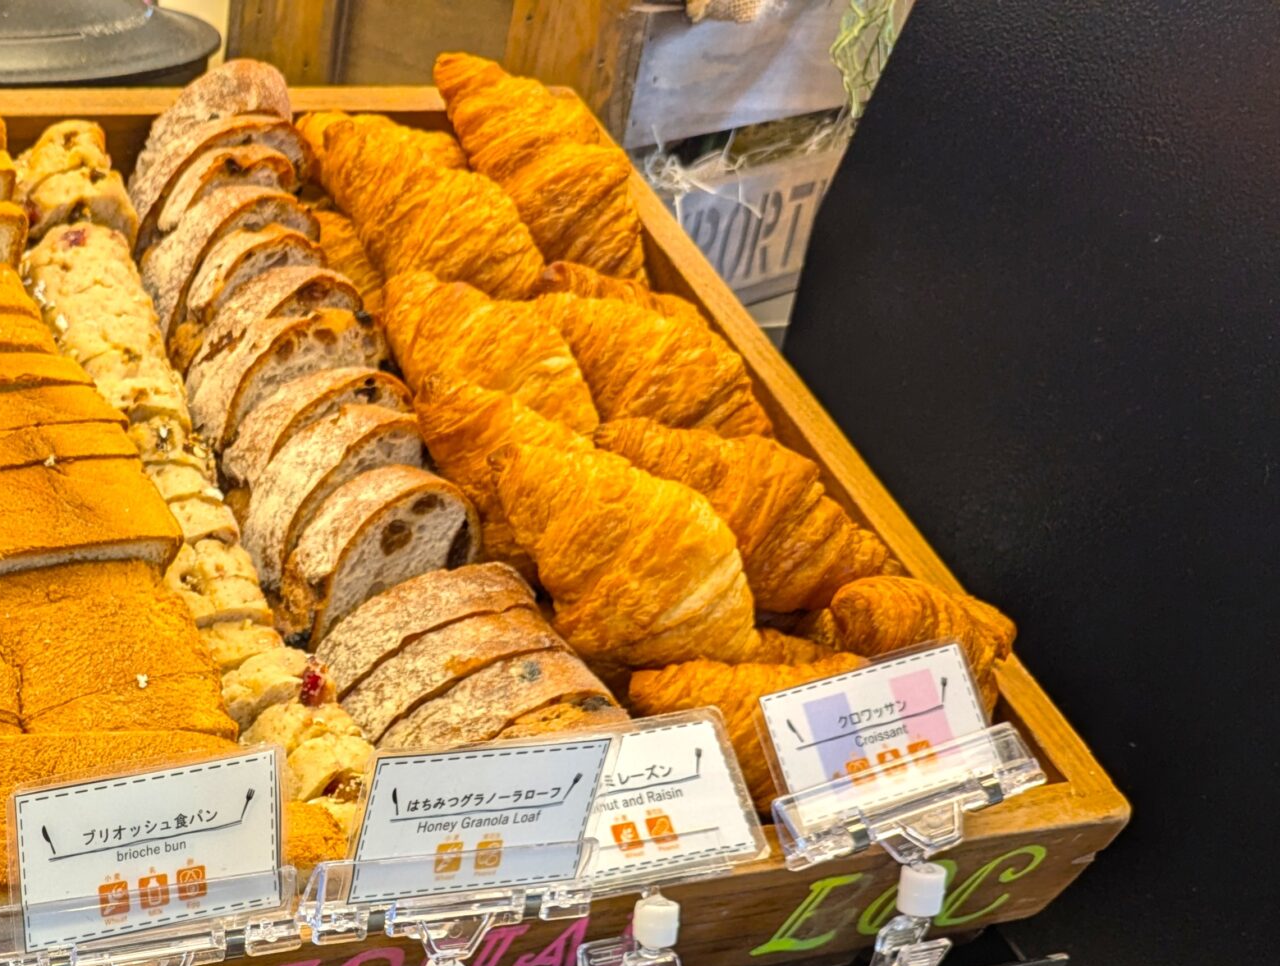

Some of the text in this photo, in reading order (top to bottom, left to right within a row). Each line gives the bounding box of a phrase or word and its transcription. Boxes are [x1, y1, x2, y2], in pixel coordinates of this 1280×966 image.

[684, 181, 817, 283] PORT
[838, 700, 907, 728] クロワッサン
[854, 724, 909, 747] Croissant
[406, 787, 561, 813] はちみつグラノーラローフ
[622, 793, 645, 808] and
[646, 787, 684, 803] Raisin
[82, 809, 218, 846] ブリオッシュ食パン
[416, 810, 541, 833] Honey Granola Loaf
[116, 840, 187, 863] brioche bun
